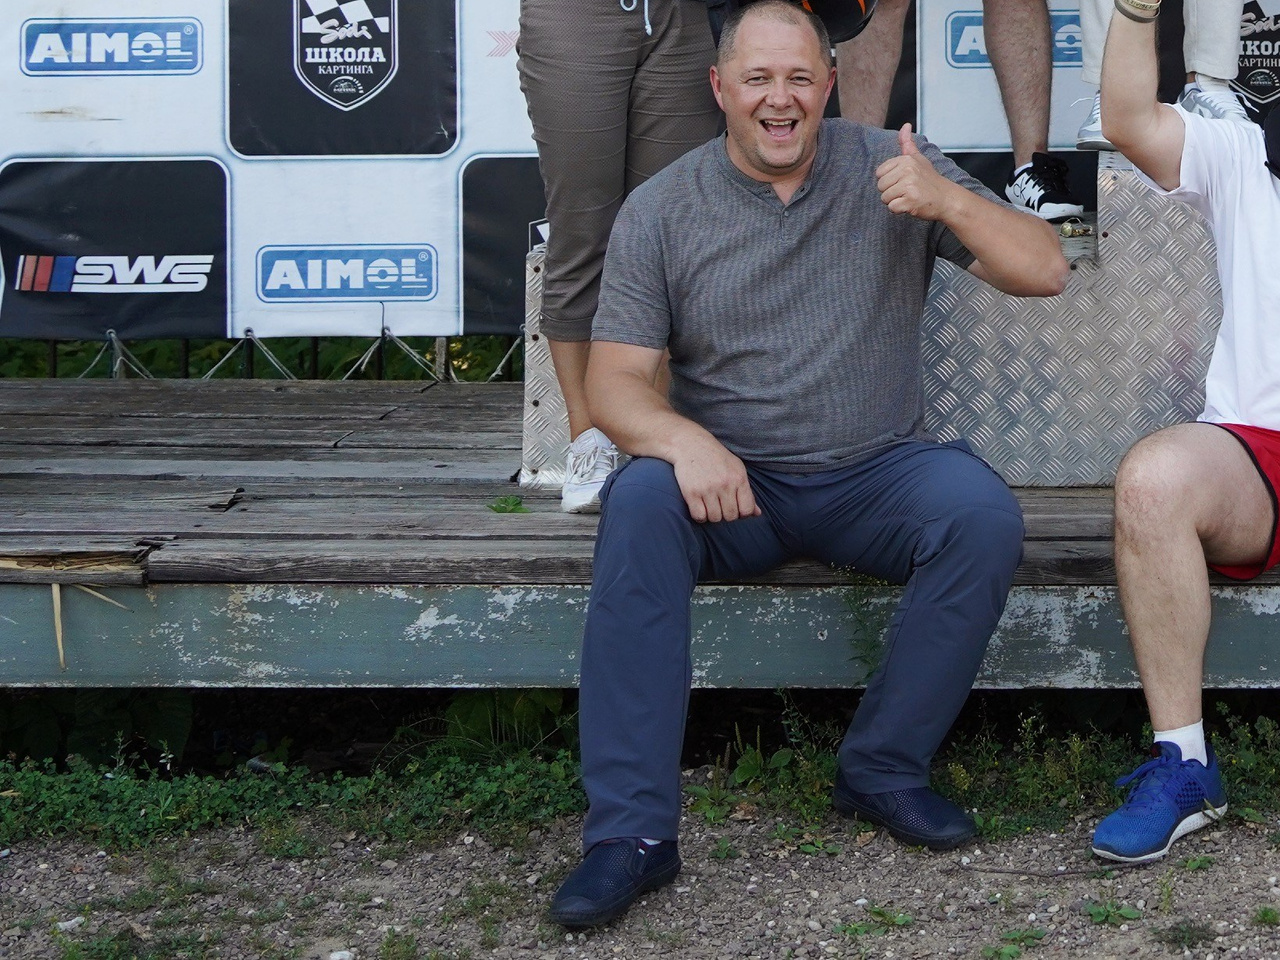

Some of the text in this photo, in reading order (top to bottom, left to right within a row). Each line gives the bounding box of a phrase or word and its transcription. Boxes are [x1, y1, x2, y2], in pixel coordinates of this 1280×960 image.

[29, 32, 193, 63] AIMOL
[305, 47, 386, 63] ШКОЛА
[318, 65, 373, 75] КАРТИНГА
[71, 255, 214, 293] SWS
[266, 262, 428, 290] AIMOL
